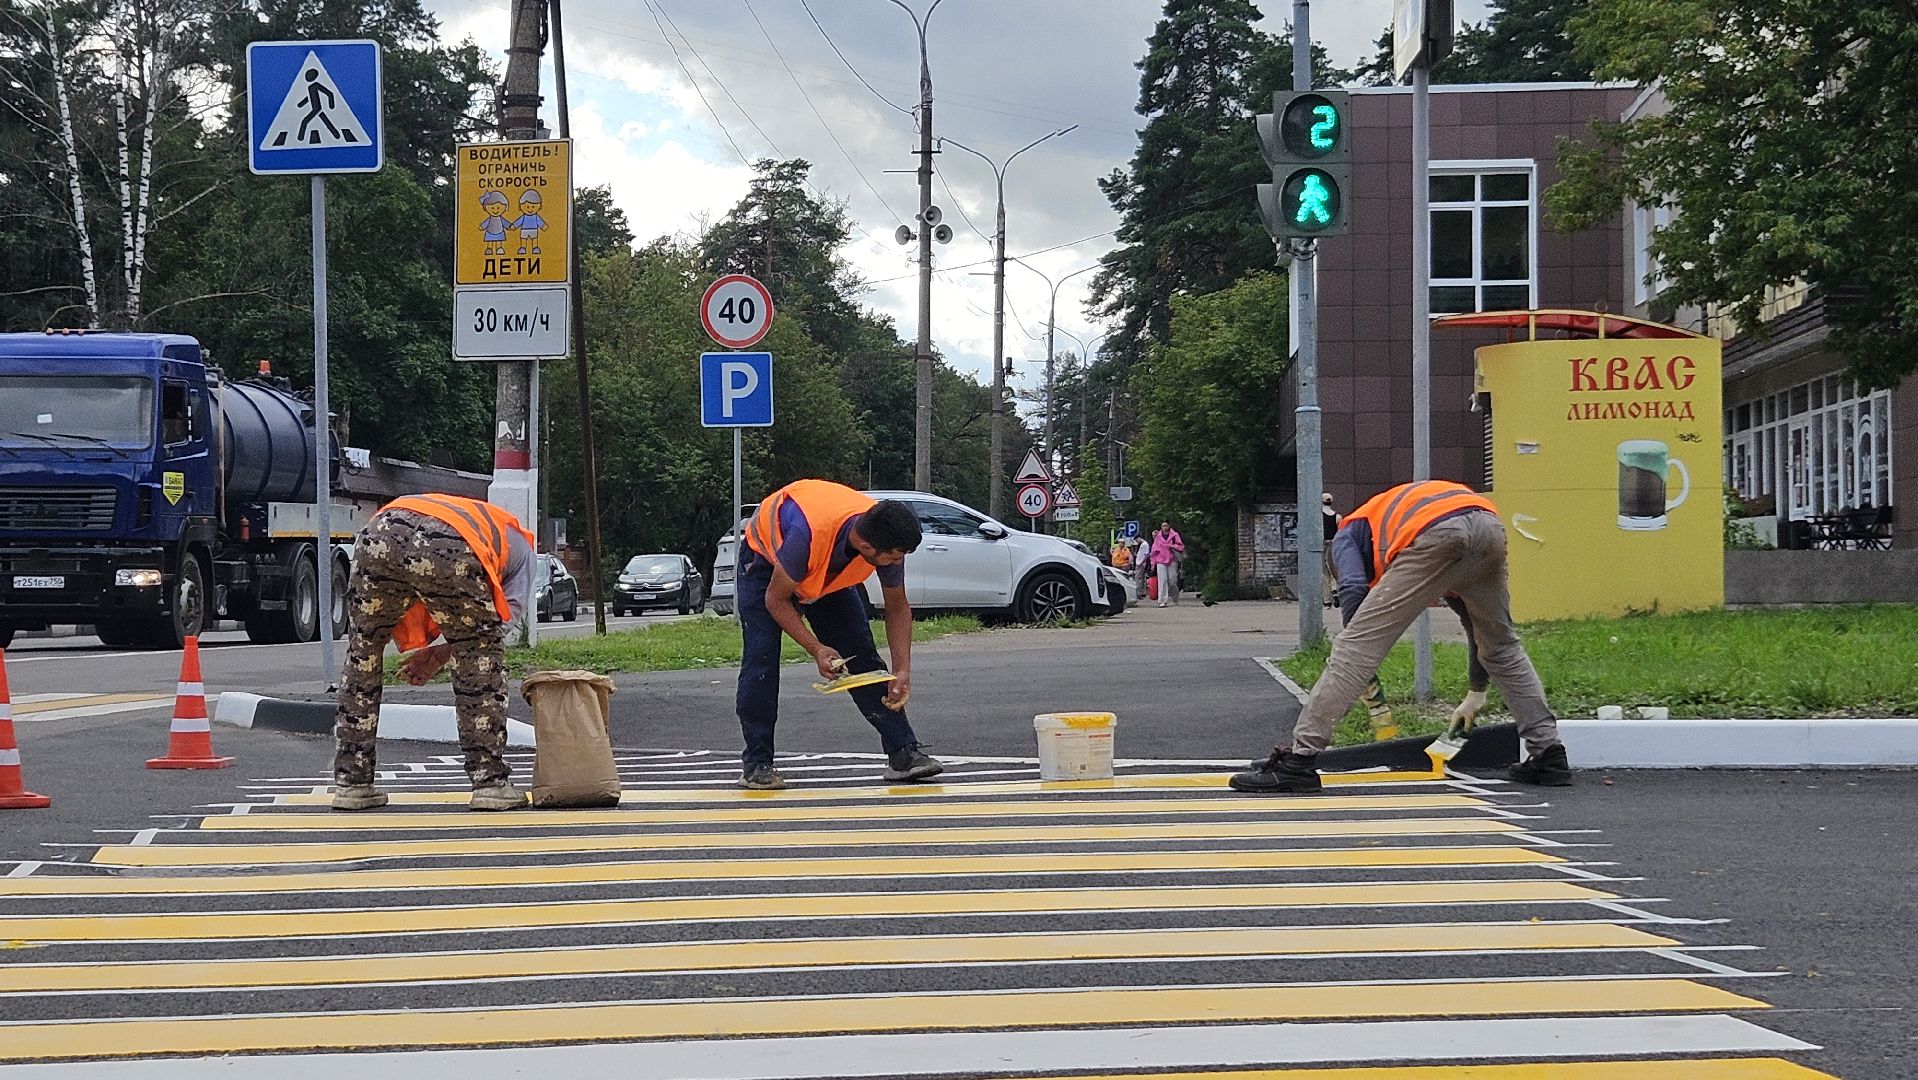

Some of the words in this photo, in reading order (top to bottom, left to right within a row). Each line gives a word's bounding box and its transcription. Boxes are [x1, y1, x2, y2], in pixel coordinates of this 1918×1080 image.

[1311, 105, 1335, 147] 2
[478, 162, 546, 175] ОГРАНИЧЬ
[478, 176, 548, 189] СКОРОСТЬ
[482, 257, 541, 279] ДЕТИ
[473, 307, 498, 333] 30
[503, 307, 550, 338] км/ч
[718, 297, 755, 324] 40
[1568, 355, 1696, 391] КВАС
[721, 362, 759, 418] P
[1024, 494, 1042, 507] 40
[1128, 523, 1136, 536] P
